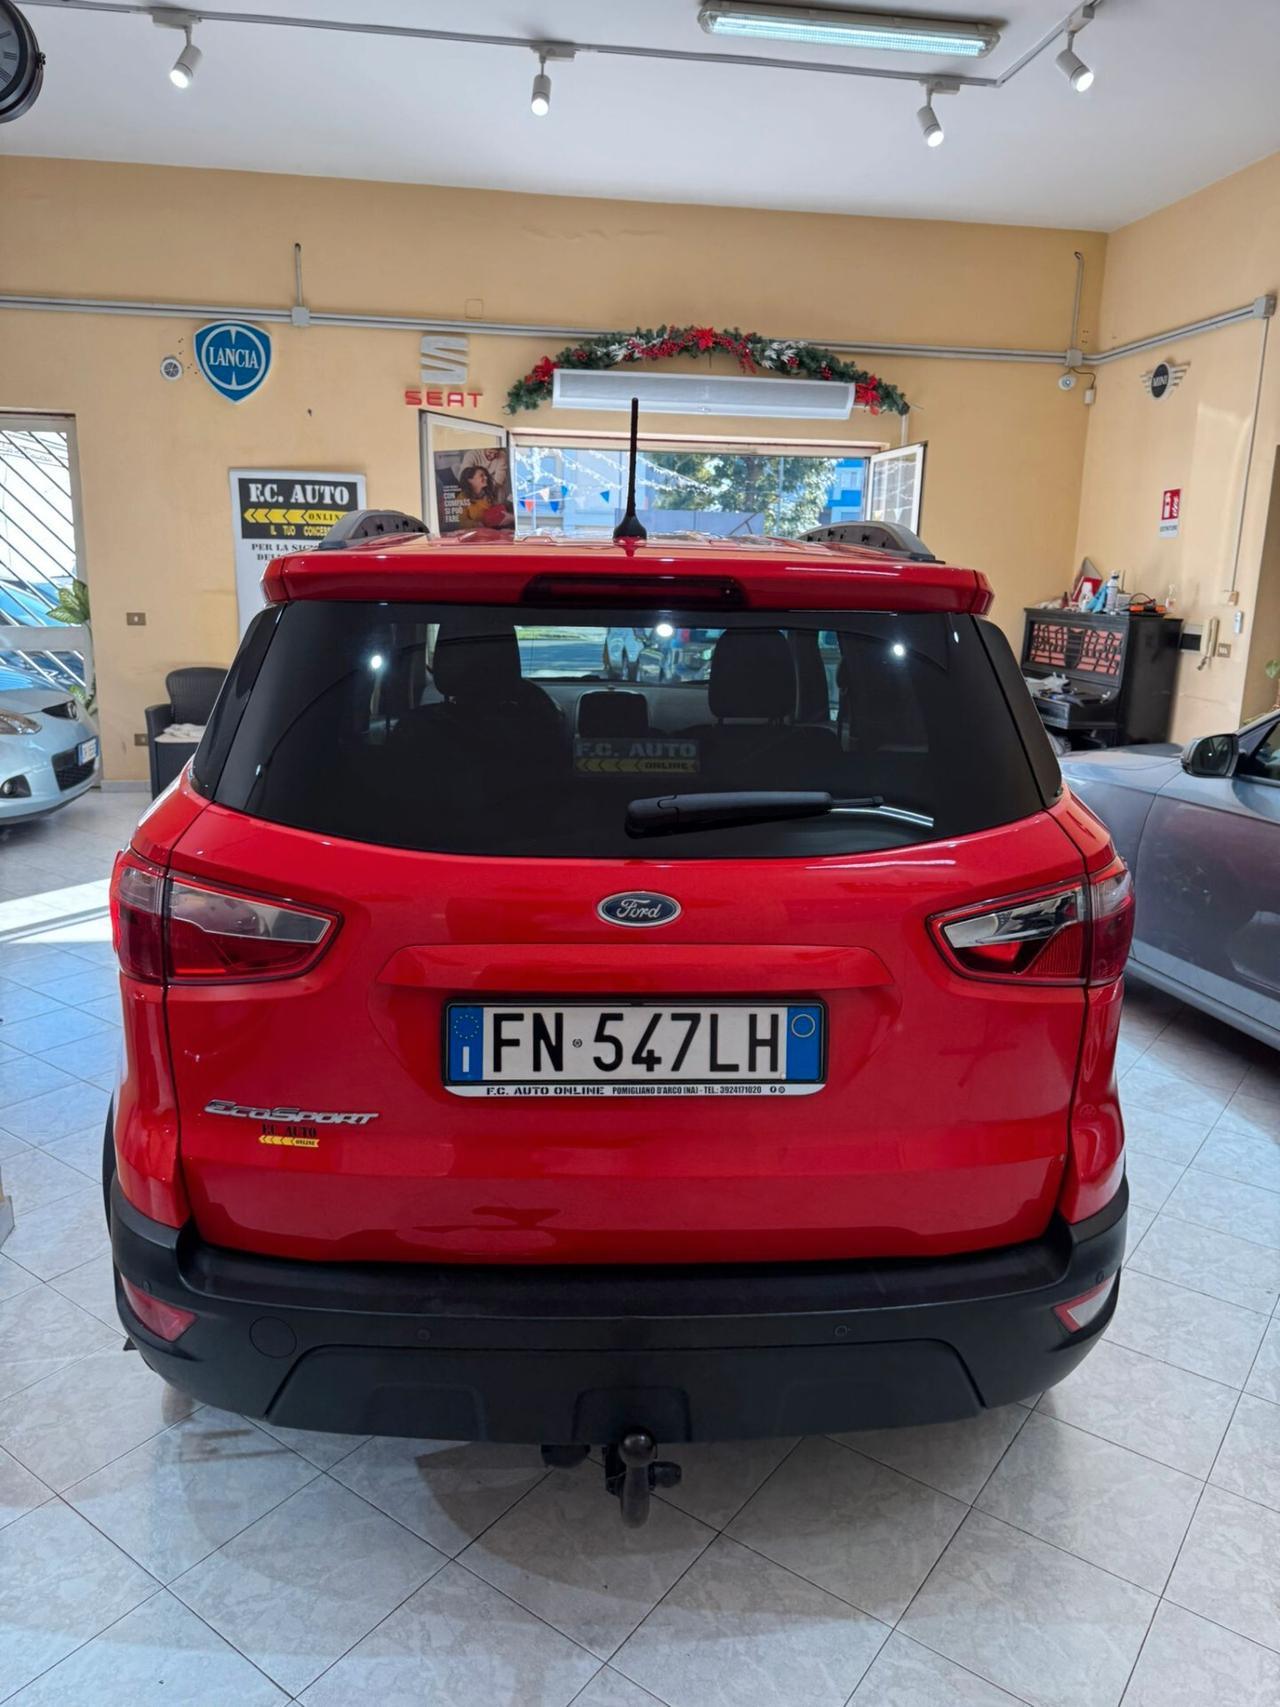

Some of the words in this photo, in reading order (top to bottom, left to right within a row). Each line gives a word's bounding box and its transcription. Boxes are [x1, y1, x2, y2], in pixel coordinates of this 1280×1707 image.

[208, 346, 260, 369] LANCIA
[405, 390, 483, 408] SEAT
[249, 483, 284, 503] F.C.
[290, 484, 350, 505] AUTO
[308, 512, 342, 521] ONLIN
[283, 526, 296, 537] TUO
[251, 543, 273, 551] PER
[276, 544, 289, 552] LA
[628, 742, 697, 757] AUTO
[644, 761, 689, 770] ONLINE
[616, 898, 662, 918] Ford
[493, 1013, 563, 1072] FN
[593, 1013, 779, 1072] 547LH
[486, 1086, 509, 1096] F.C.
[513, 1086, 551, 1096] AUTO
[554, 1086, 605, 1096] ONLINE
[612, 1086, 656, 1095] POMIGLIANO
[657, 1086, 682, 1095] D'ARCO
[285, 1125, 317, 1138] AUTO
